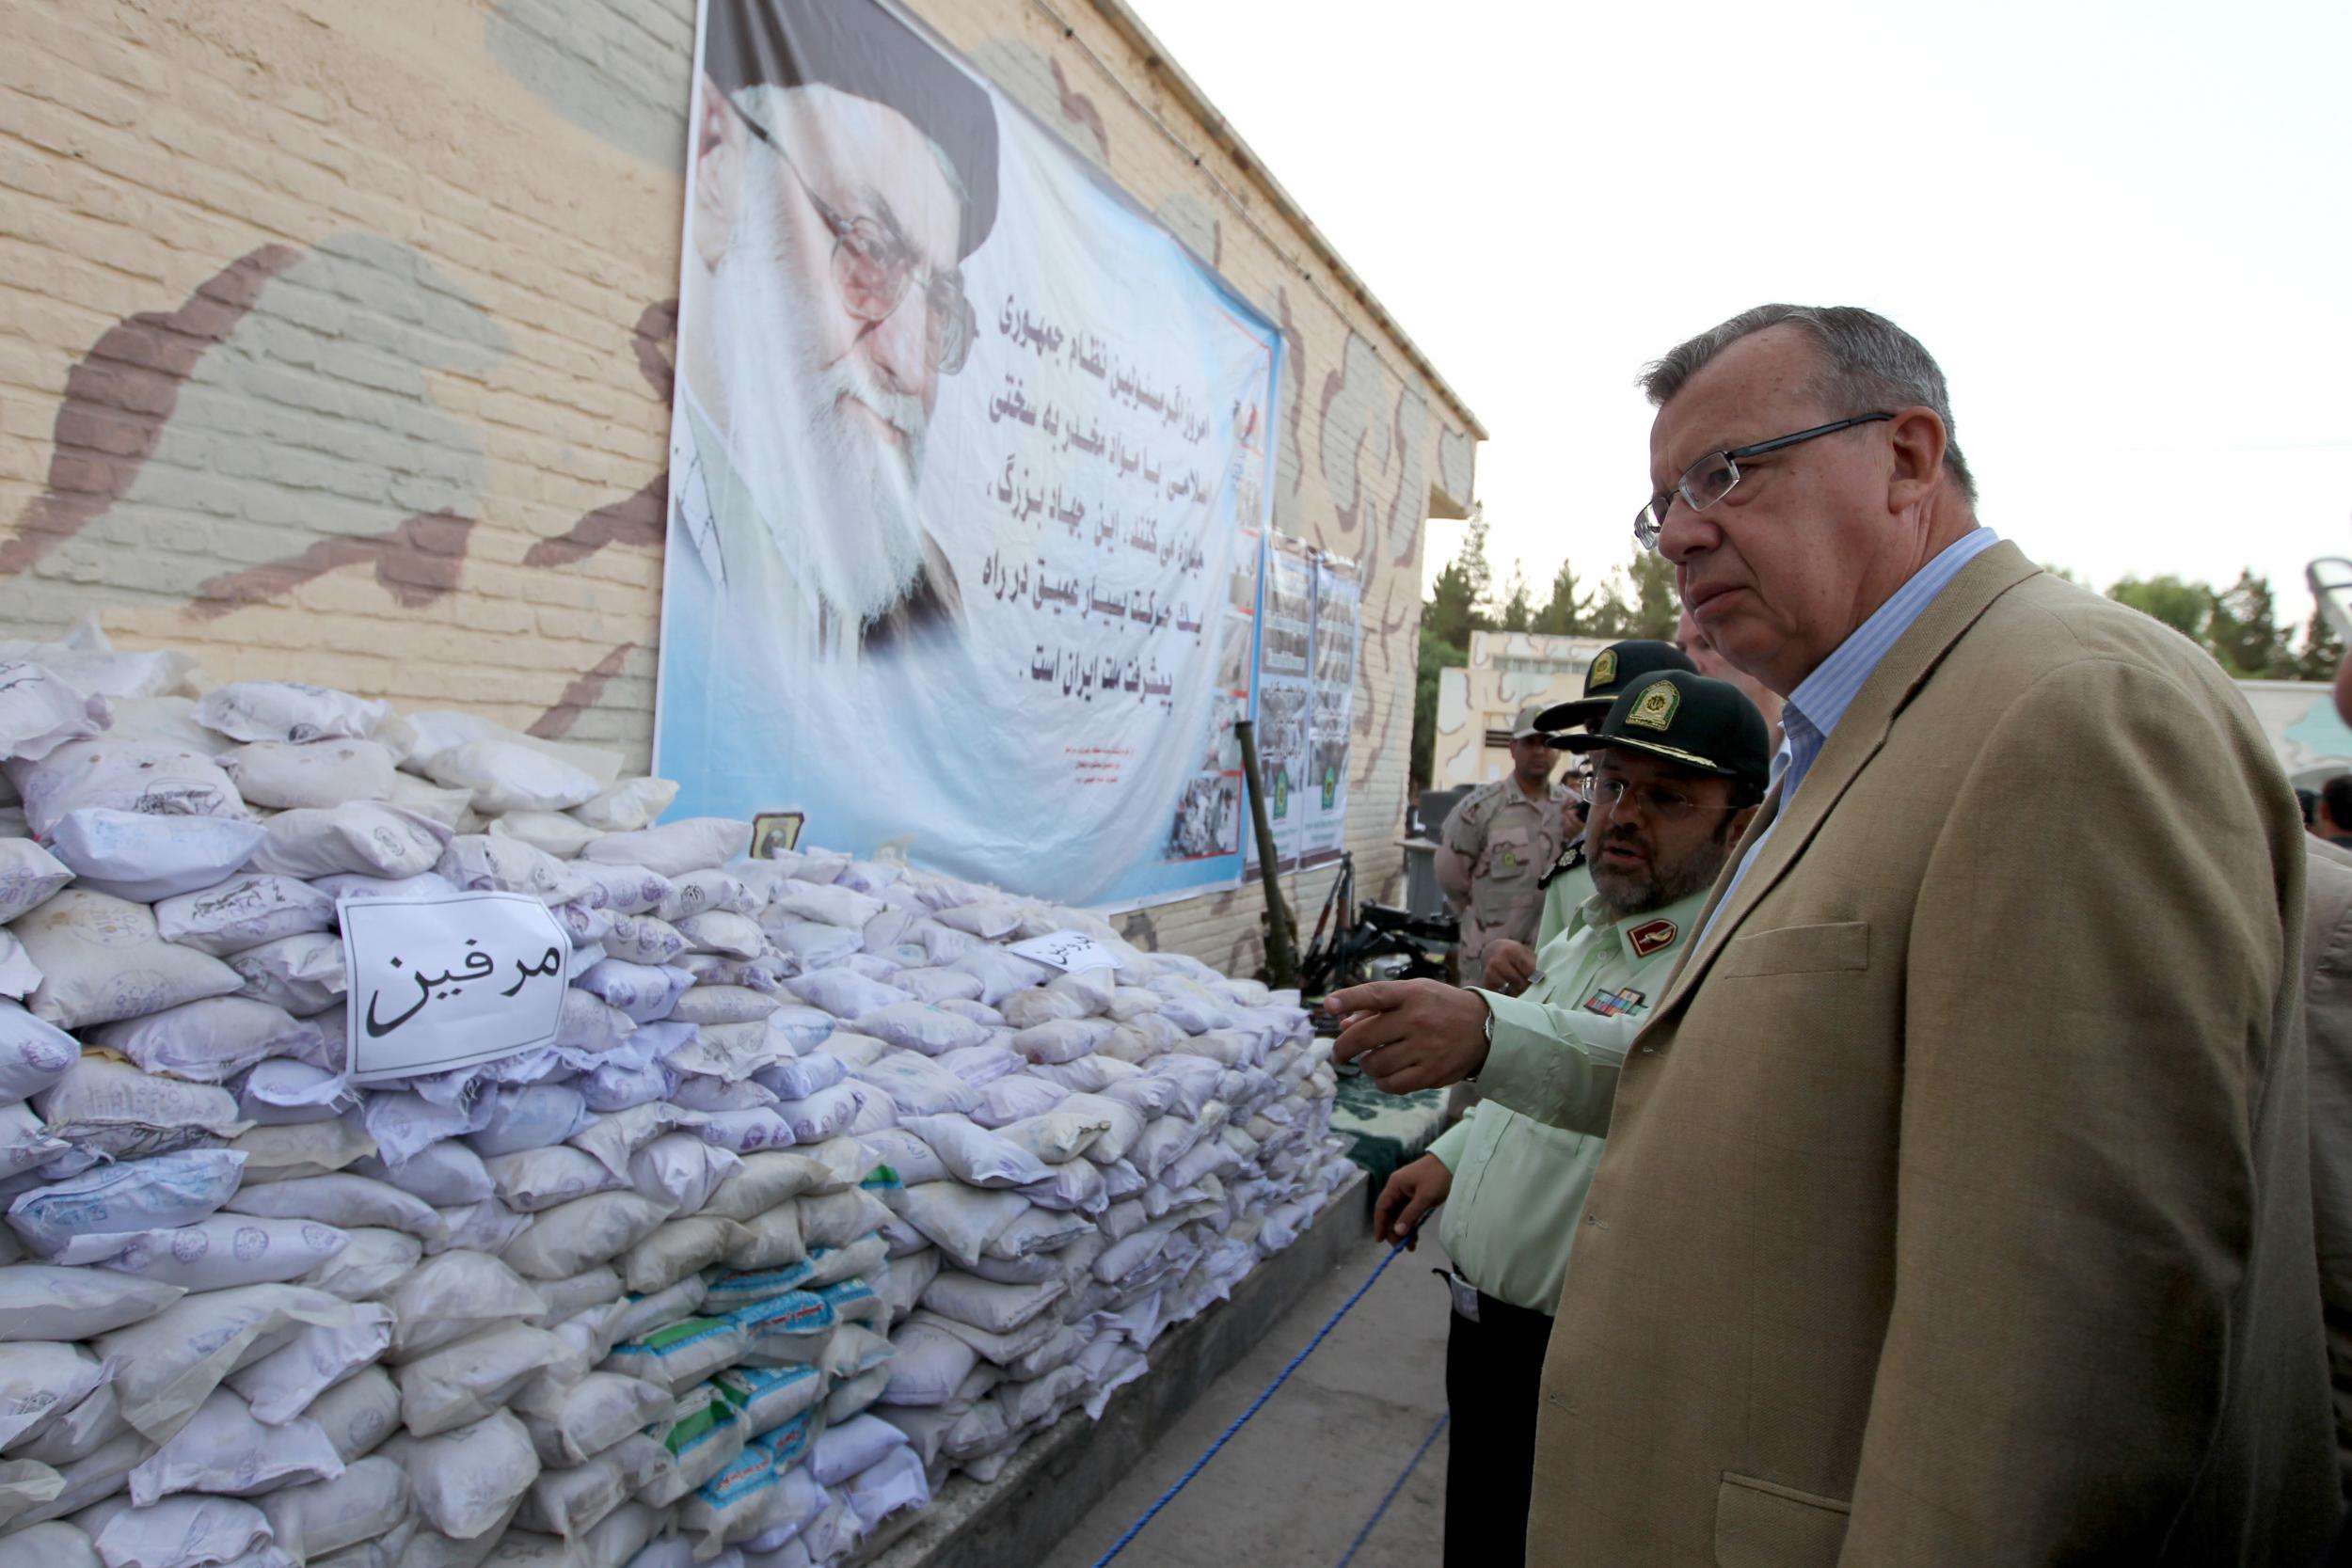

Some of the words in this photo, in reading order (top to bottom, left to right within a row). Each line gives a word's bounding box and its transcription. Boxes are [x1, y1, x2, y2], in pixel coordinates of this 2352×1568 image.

[1069, 331, 1106, 380] نظام
[989, 373, 1036, 427] سختی
[1042, 400, 1059, 452] به
[1061, 415, 1105, 455] مخدر
[1109, 432, 1139, 478] مواد
[997, 453, 1044, 530] بزرگ
[1143, 446, 1161, 499] با
[1050, 483, 1085, 539] جهاد
[1094, 500, 1119, 553] این
[982, 547, 1005, 600] راه
[1008, 562, 1027, 603] در
[1033, 558, 1078, 615] عمیق
[1082, 575, 1126, 632] بسیار
[1131, 589, 1172, 635] حرکت
[1032, 645, 1060, 681] است
[1063, 652, 1098, 702] ایران
[1102, 657, 1120, 689] ملت
[365, 939, 561, 1038] مرفین
